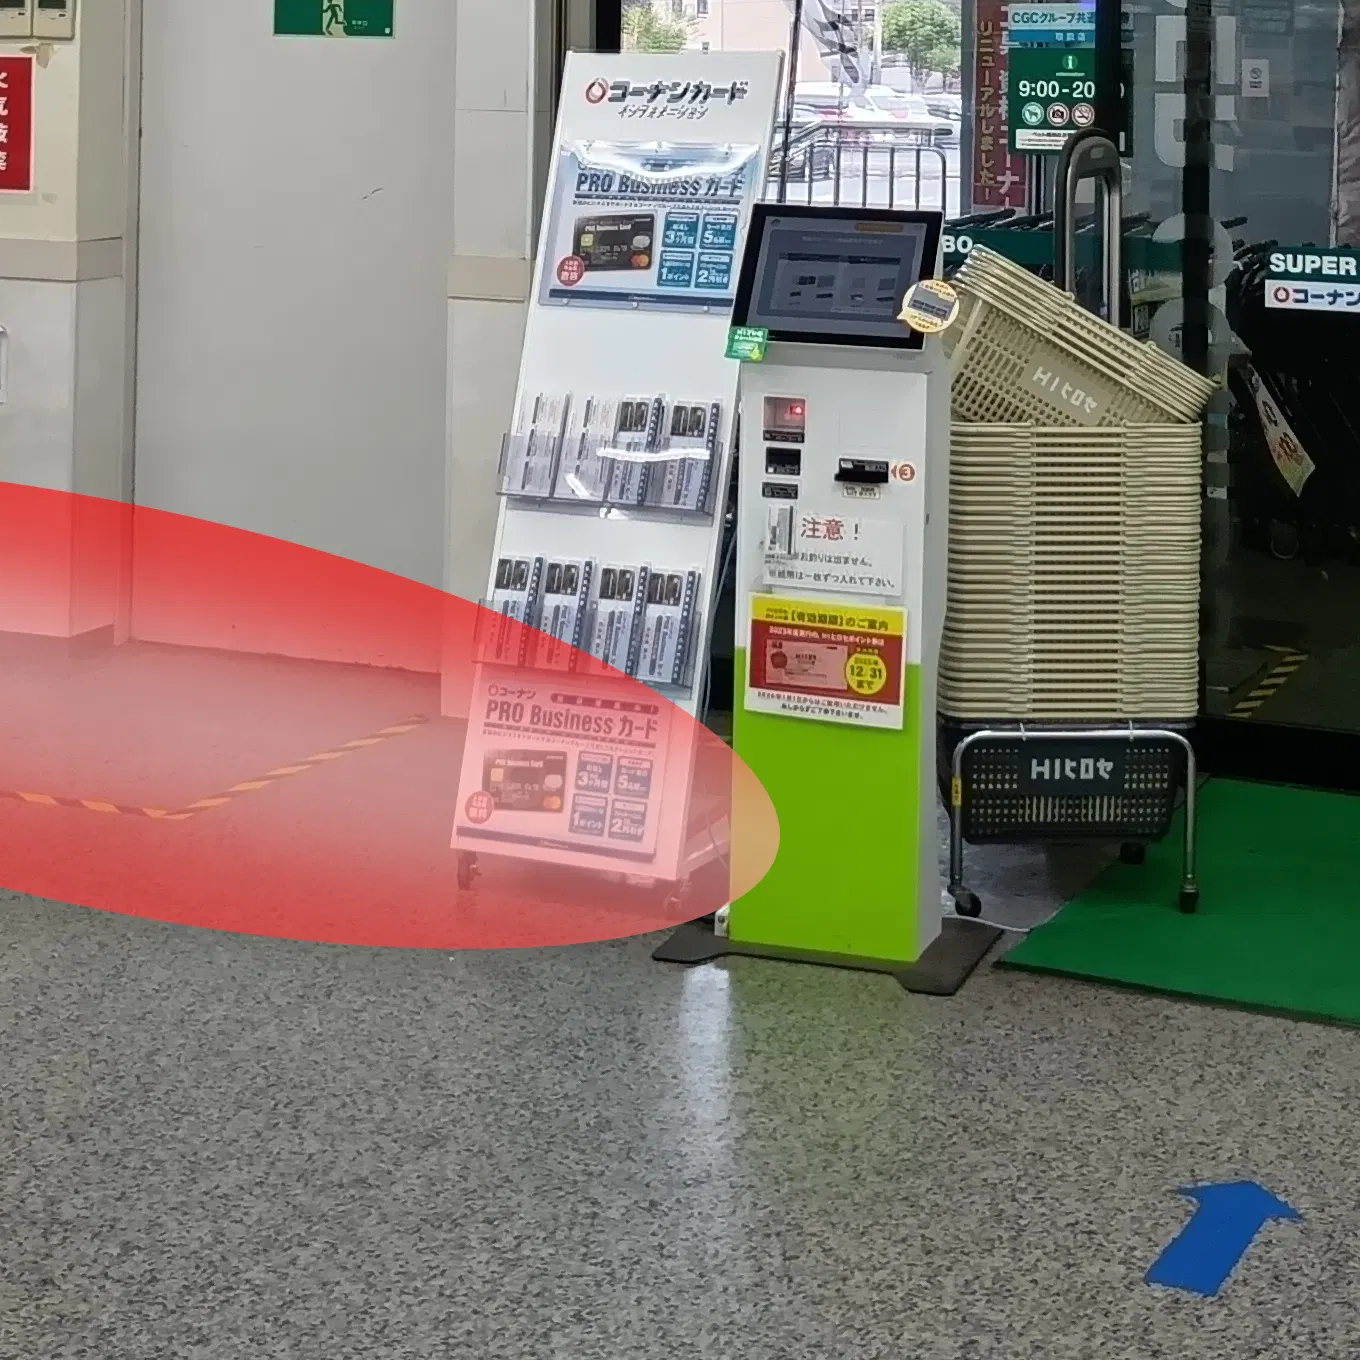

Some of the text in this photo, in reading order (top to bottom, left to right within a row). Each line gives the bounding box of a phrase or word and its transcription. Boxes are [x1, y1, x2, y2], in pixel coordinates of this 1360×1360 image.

[608, 80, 749, 105] コーナンカード
[575, 170, 613, 193] PRO
[1269, 252, 1358, 277] SUPER
[485, 699, 660, 740] PRO Business カード
